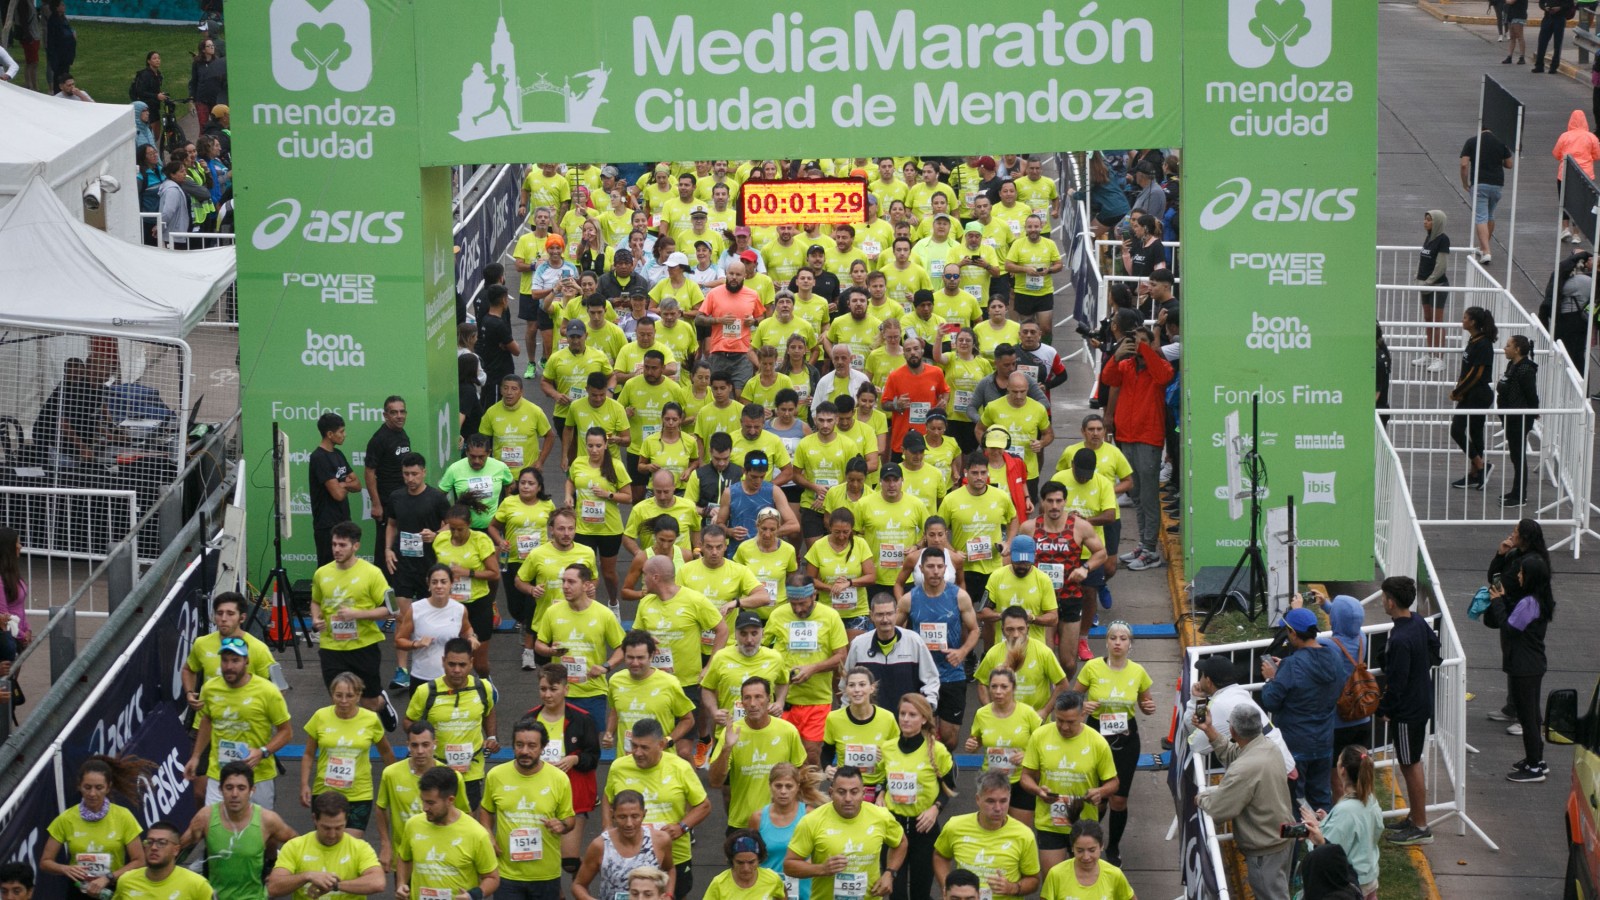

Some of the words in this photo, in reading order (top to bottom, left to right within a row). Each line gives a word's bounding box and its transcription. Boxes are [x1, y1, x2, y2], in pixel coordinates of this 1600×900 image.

[633, 1, 1154, 77] MediaMaratón
[1206, 74, 1353, 103] mendoza
[253, 98, 396, 127] mendoza
[634, 86, 816, 132] Ciudad
[831, 83, 897, 128] de
[913, 78, 1154, 126] Mendoza
[1230, 107, 1328, 136] ciudad
[277, 131, 373, 159] ciudad
[747, 192, 863, 214] 00:01:29
[1230, 252, 1326, 269] POWER
[283, 273, 376, 288] POWER
[1245, 332, 1312, 354] aqua
[301, 350, 365, 371] aqua
[1214, 384, 1286, 404] Fondos
[1292, 384, 1343, 404] Fima
[348, 402, 386, 422] Fim
[1294, 431, 1345, 449] amanda
[1308, 481, 1331, 493] ibis
[1036, 542, 1070, 552] KENYA
[1216, 539, 1262, 547] MENDOA
[1296, 539, 1340, 547] RGENTINA
[281, 554, 318, 562] MENDOZ
[1103, 721, 1124, 729] 1482
[848, 753, 873, 762] 1060
[989, 755, 1008, 763] 204
[329, 764, 351, 775] 1422
[890, 781, 914, 790] 2038
[514, 837, 537, 846] 1514
[841, 882, 862, 891] 652
